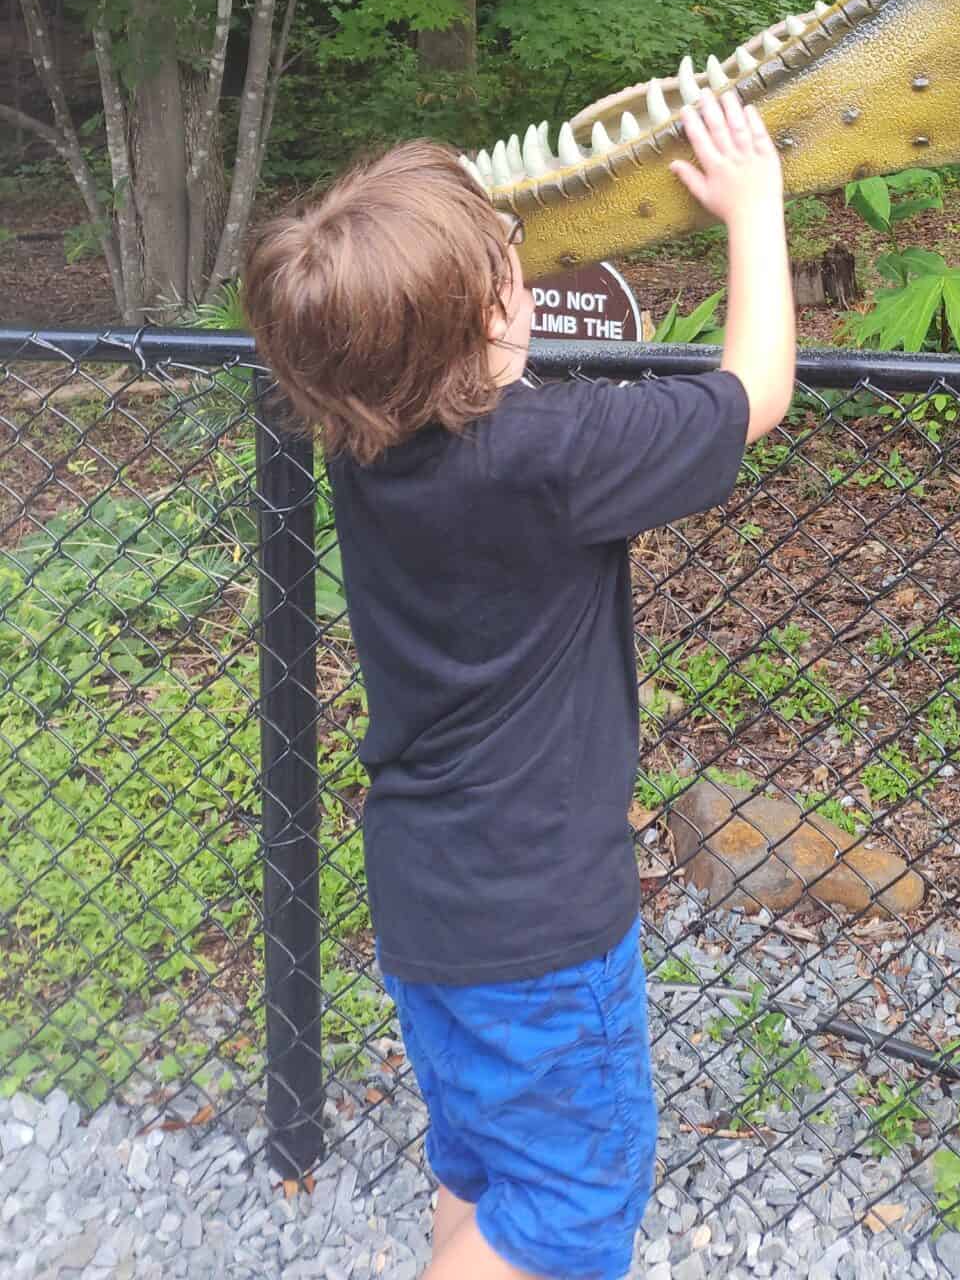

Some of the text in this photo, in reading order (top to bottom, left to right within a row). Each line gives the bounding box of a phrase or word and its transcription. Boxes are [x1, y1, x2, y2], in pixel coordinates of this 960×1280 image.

[532, 287, 607, 313] DO NOT
[530, 312, 623, 340] LIMB THE
